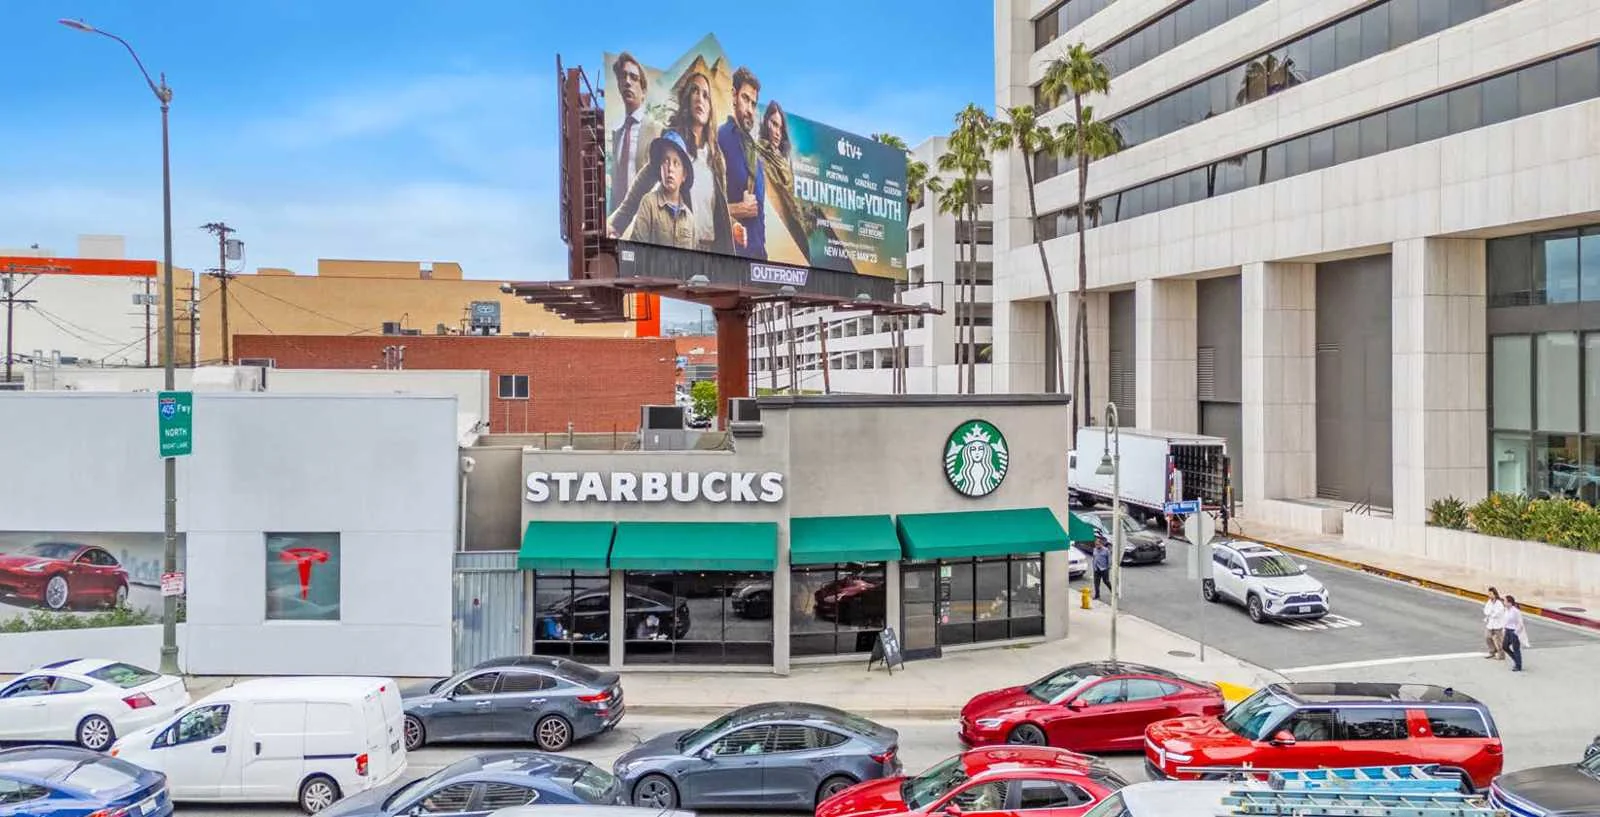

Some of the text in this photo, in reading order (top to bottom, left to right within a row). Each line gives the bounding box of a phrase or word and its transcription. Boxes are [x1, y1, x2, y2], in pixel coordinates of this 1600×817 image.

[794, 175, 902, 221] FOUNTAIN OF YOUTH
[824, 246, 838, 257] NEW
[839, 247, 857, 260] MOVIE
[753, 267, 804, 284] OUTFRONT
[162, 404, 190, 415] 405 Fwy
[165, 428, 187, 436] NORTH
[525, 471, 784, 503] STARBUCKS
